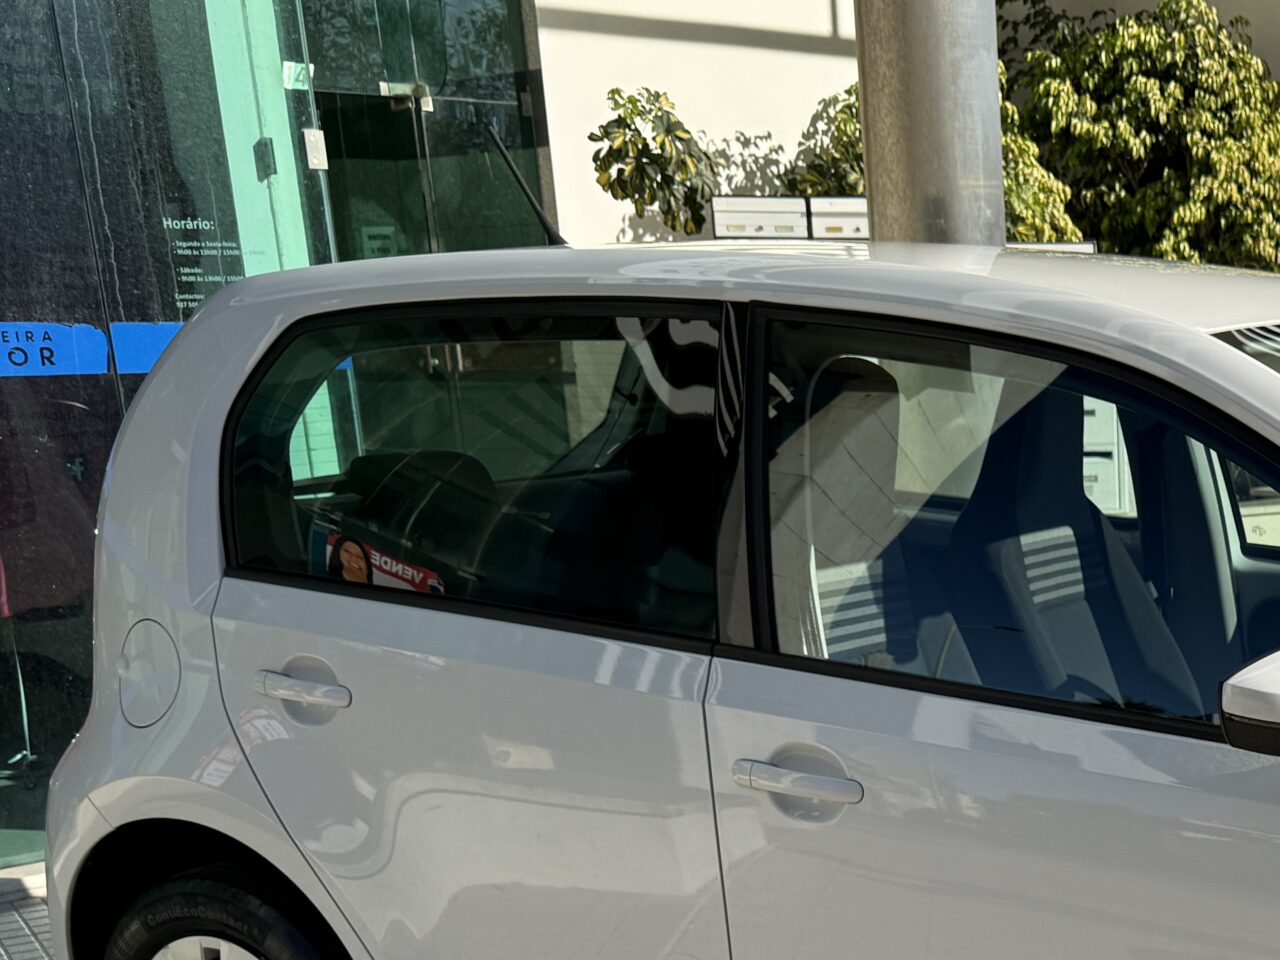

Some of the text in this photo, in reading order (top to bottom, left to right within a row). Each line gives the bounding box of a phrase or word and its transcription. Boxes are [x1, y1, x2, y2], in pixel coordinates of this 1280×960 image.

[162, 217, 215, 230] Horário:
[1, 330, 53, 343] EIRA
[8, 346, 57, 367] OR
